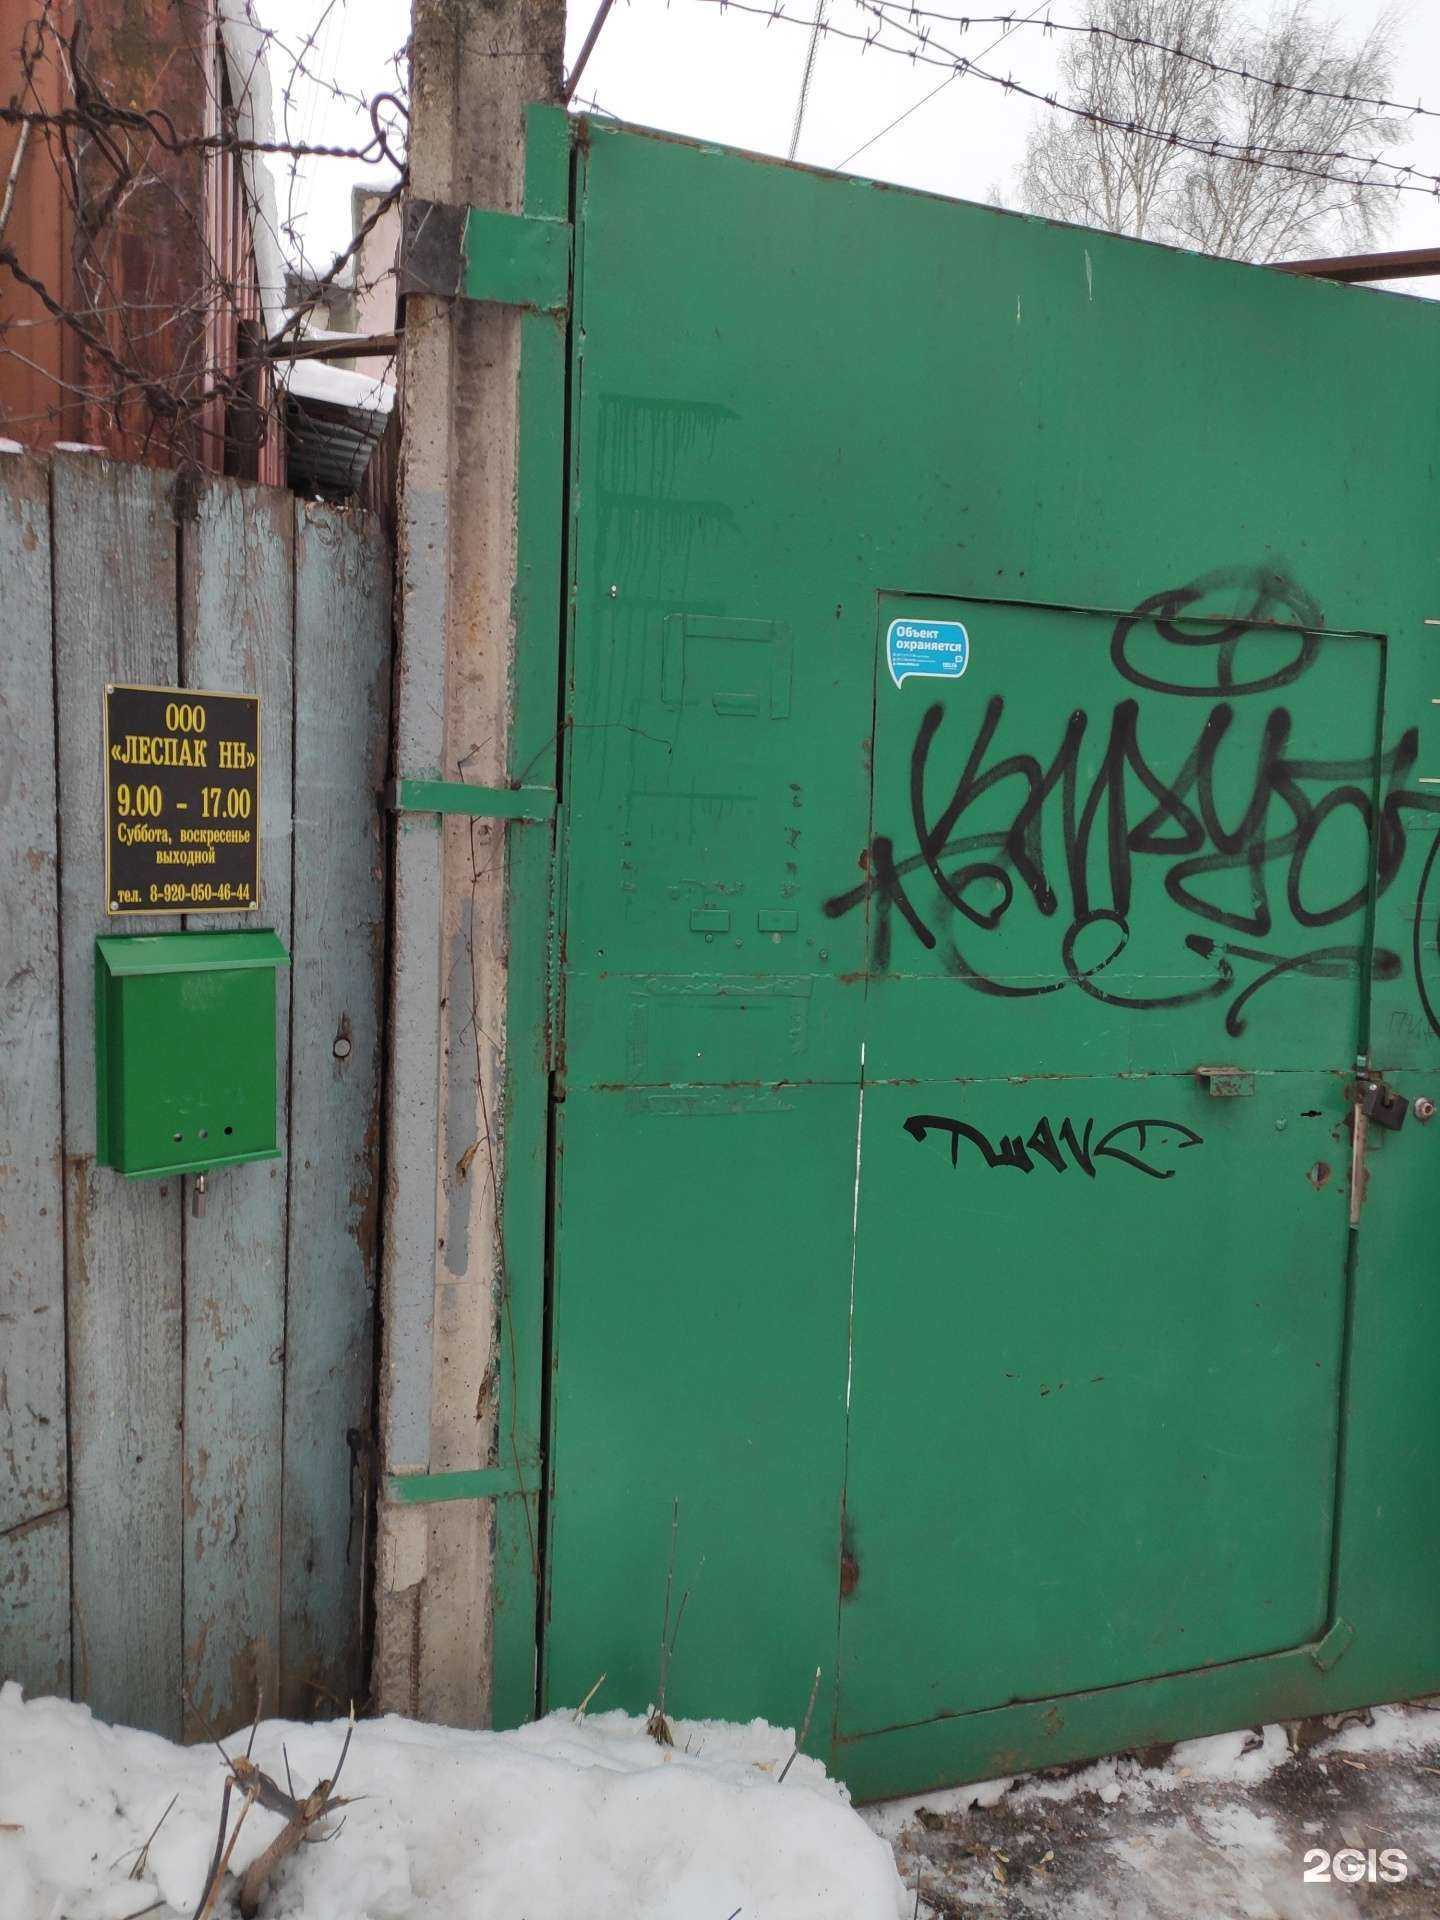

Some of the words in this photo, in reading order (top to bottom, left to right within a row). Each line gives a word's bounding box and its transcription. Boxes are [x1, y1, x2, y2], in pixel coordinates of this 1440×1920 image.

[896, 626, 939, 639] Объект
[896, 640, 962, 652] охраняется
[165, 703, 206, 733] ООО
[111, 735, 208, 767] «ЛЕСПАК
[218, 740, 256, 769] НН»
[117, 784, 162, 817] 9.00
[200, 787, 251, 819] 17.00
[117, 822, 172, 847] Суббота,
[180, 827, 250, 847] воскресенье
[156, 847, 216, 867] выходной
[117, 888, 142, 904] тел.
[150, 883, 250, 903] 8-920-050-46-44
